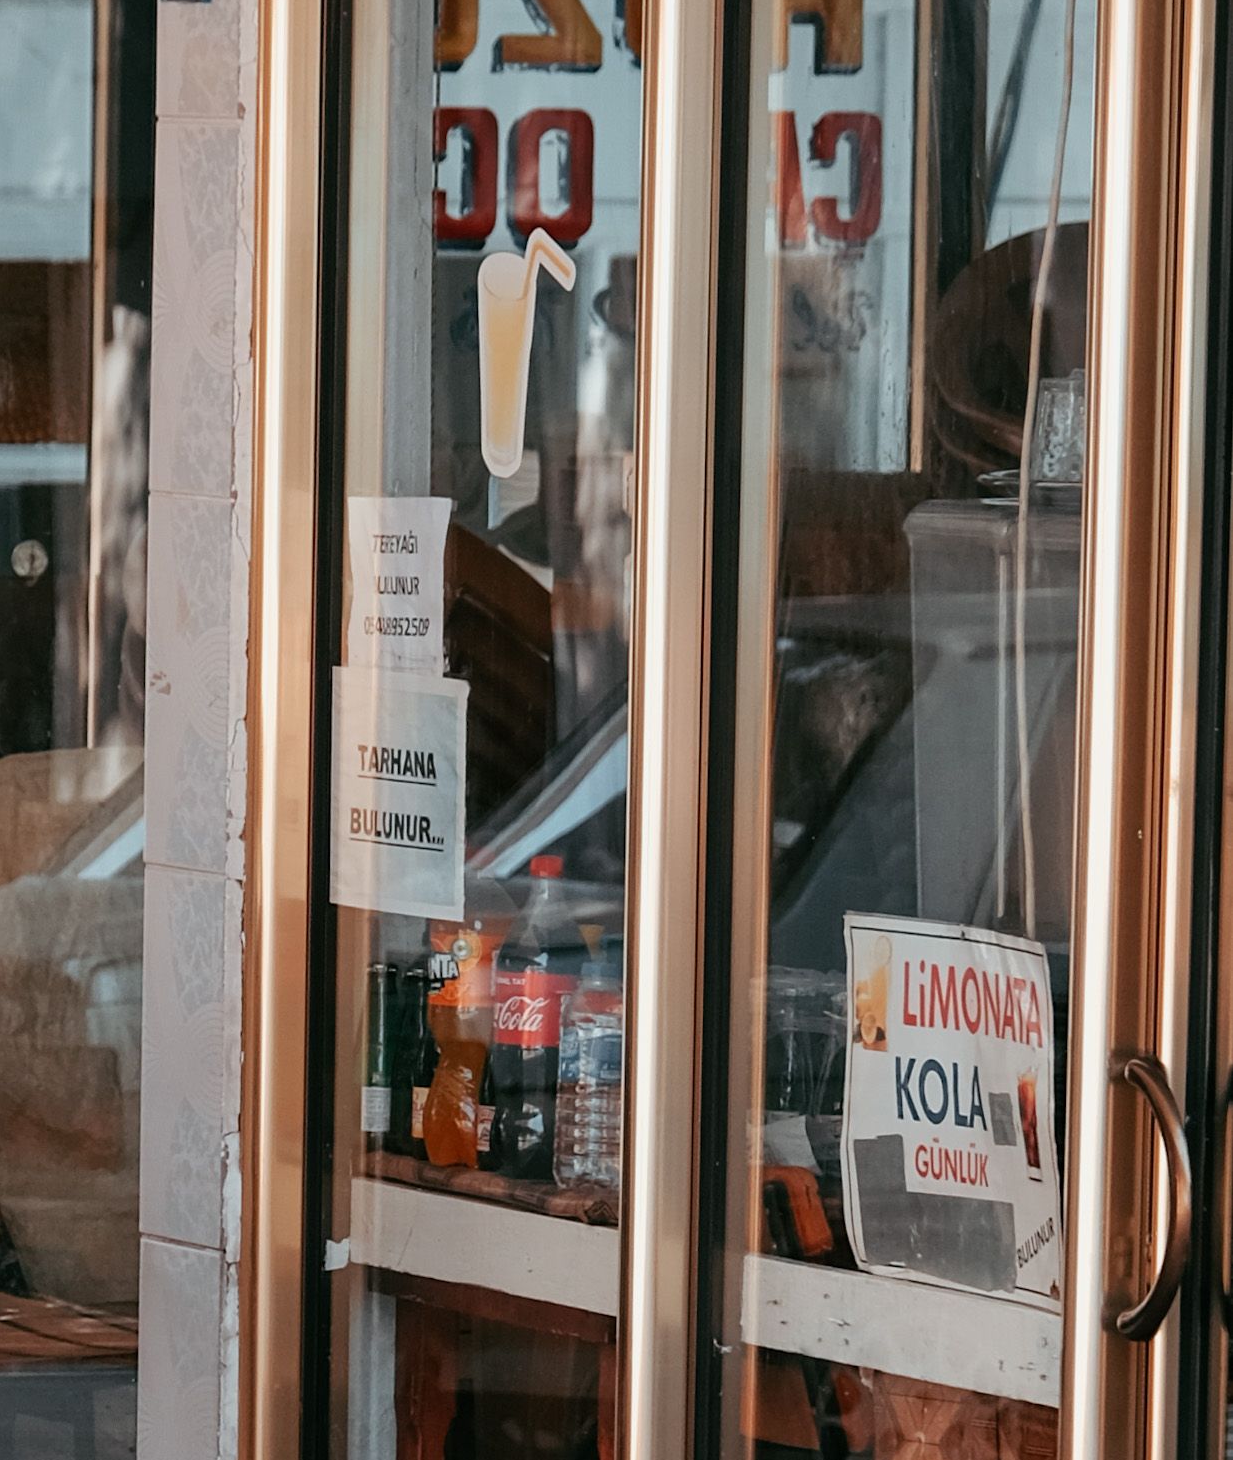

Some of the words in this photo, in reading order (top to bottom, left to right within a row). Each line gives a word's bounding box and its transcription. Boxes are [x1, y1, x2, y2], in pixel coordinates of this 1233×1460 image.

[375, 575, 420, 595] ULUNUR
[357, 744, 437, 780] TARHANA
[350, 807, 444, 846] BULUNUR...
[894, 1055, 988, 1132] KOLA
[914, 1138, 990, 1188] GÜNLÜK
[1017, 1217, 1055, 1269] BULUNUR
